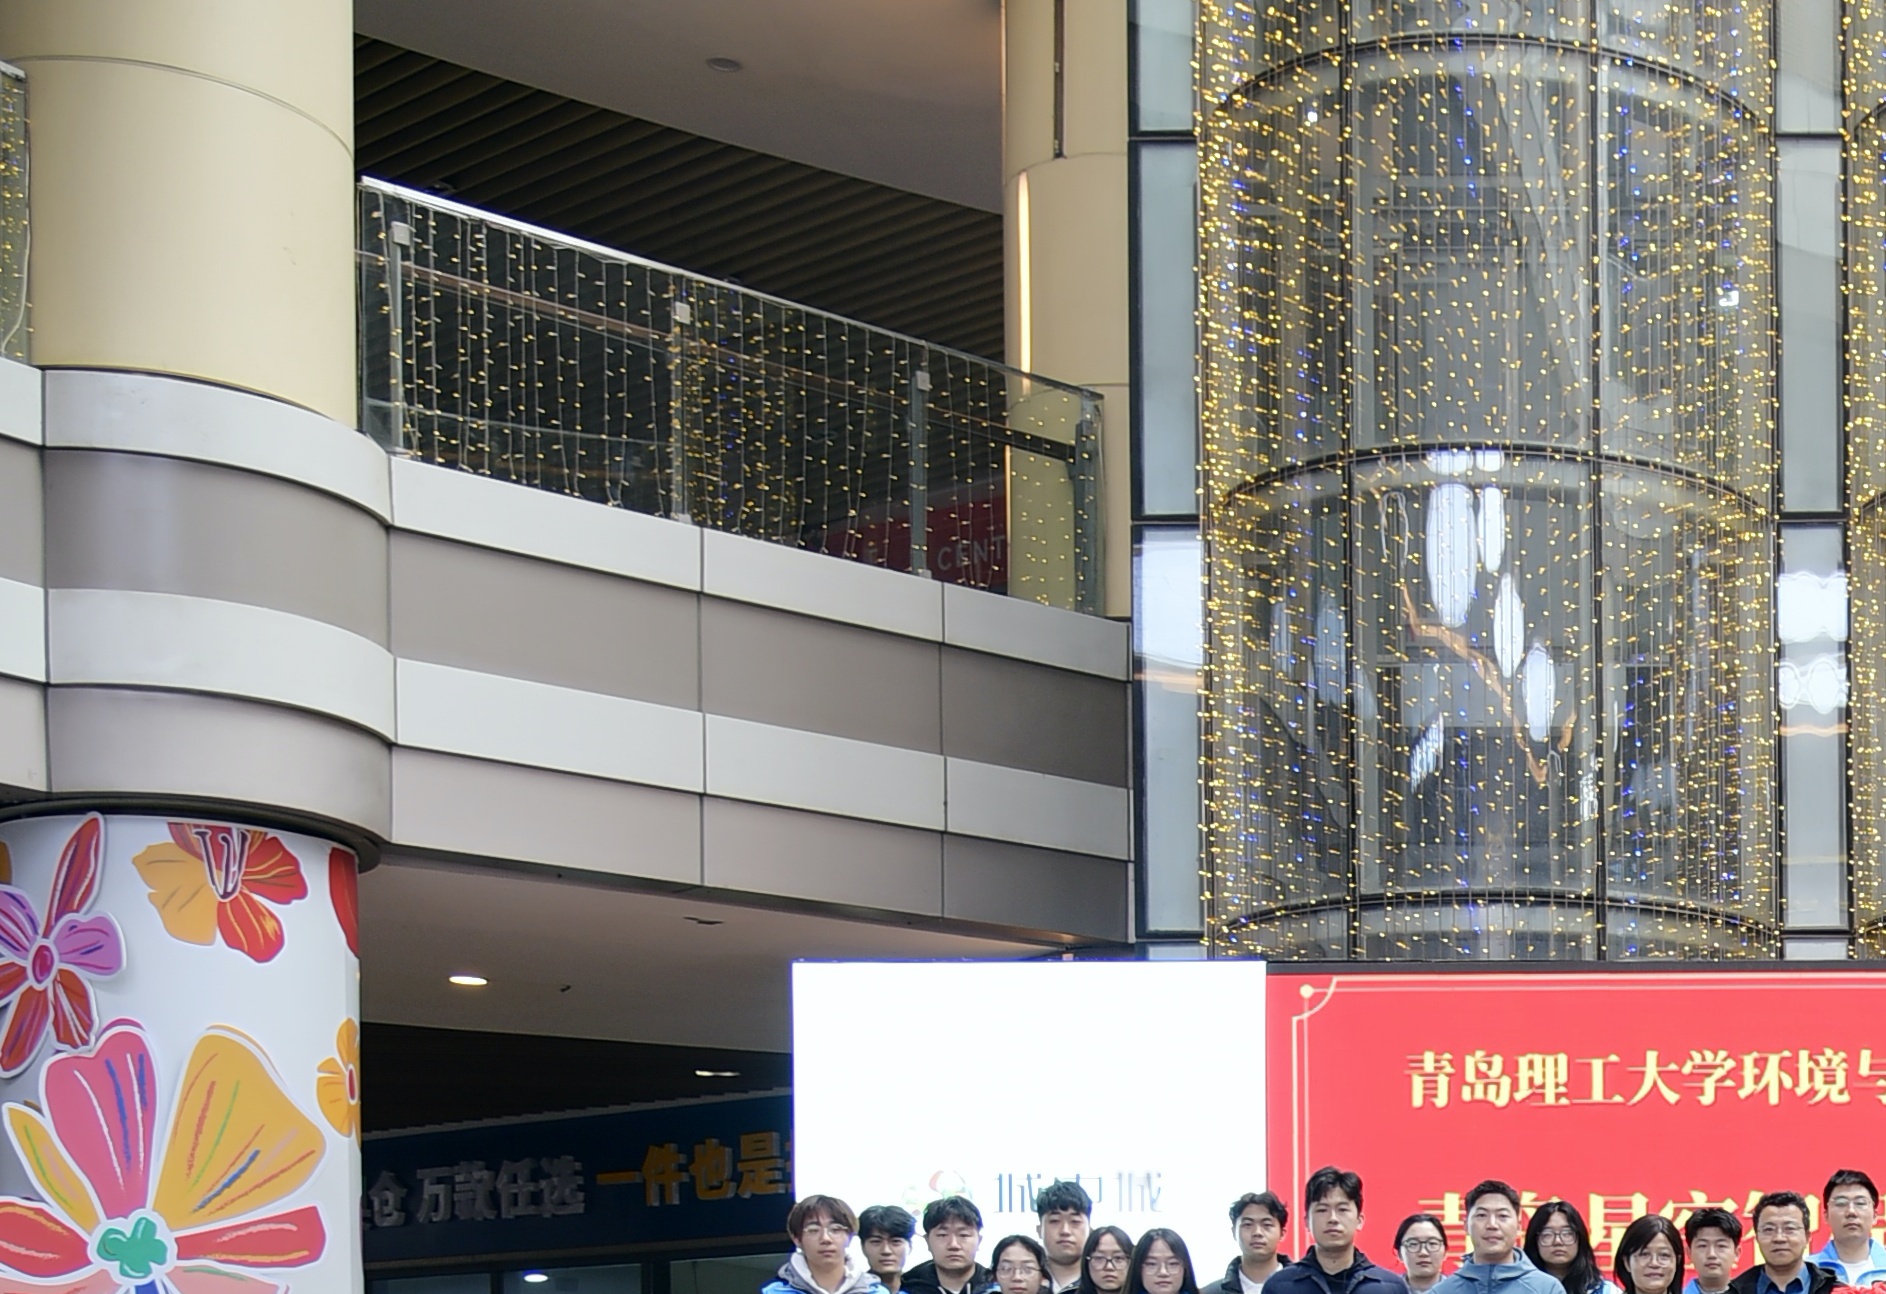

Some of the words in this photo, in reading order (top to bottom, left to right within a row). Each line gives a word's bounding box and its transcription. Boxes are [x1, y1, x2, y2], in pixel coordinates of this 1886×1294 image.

[363, 1170, 407, 1230] 仓
[416, 1154, 586, 1224] 万款任选
[597, 1130, 793, 1208] 一件也是
